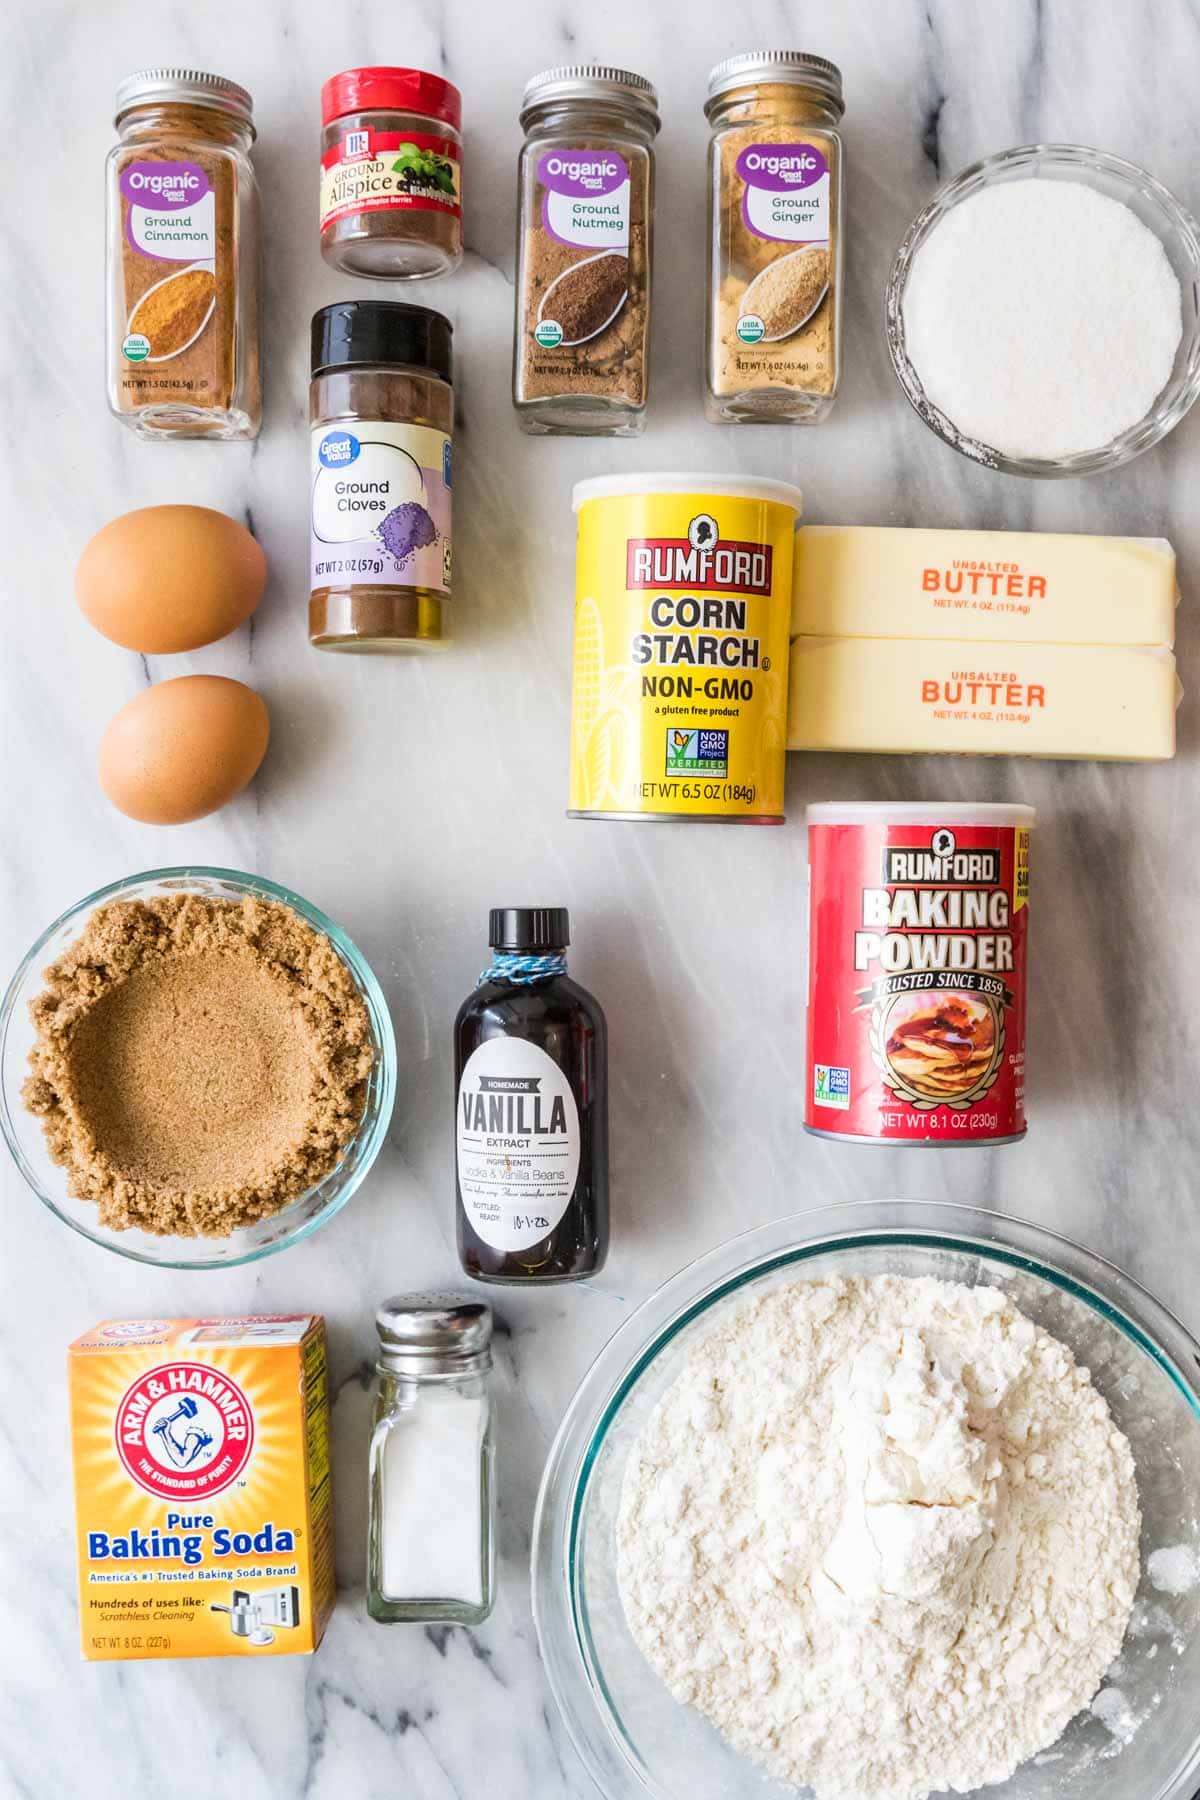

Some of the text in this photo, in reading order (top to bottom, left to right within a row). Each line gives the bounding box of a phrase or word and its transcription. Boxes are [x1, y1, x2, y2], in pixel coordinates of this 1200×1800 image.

[547, 157, 618, 180] Organic
[746, 152, 817, 175] Organic
[334, 161, 385, 184] GROUND
[129, 170, 200, 194] Organic
[329, 175, 393, 206] Allspice
[572, 203, 620, 215] Ground
[772, 197, 820, 208] Ground
[144, 216, 192, 227] Ground
[772, 211, 815, 224] Ginger
[572, 218, 625, 231] Nutmeg
[144, 230, 209, 241] Cinnamon
[742, 321, 759, 329] USDA
[751, 361, 761, 370] WT
[775, 362, 783, 370] OZ
[321, 440, 352, 453] Great
[335, 480, 390, 494] Ground
[337, 498, 387, 511] Cloves
[315, 559, 384, 575] NET WT 2 OZ (57g)
[633, 546, 768, 588] RUMFORD
[952, 560, 1019, 573] UNSALTED
[922, 569, 1047, 598] BUTTER
[651, 597, 747, 630] CORN
[933, 600, 951, 608] NET
[972, 601, 977, 609] 4
[996, 602, 1031, 615] (113.4g)
[631, 634, 760, 669] STARCH
[951, 671, 1017, 682] UNSALTED
[641, 675, 753, 701] NON-GMO
[921, 680, 1045, 708] BUTTER
[662, 705, 689, 715] gluten
[691, 706, 708, 715] free
[709, 707, 740, 717] product
[933, 710, 951, 719] NET
[700, 732, 726, 741] NON
[700, 741, 726, 750] GMO
[700, 749, 725, 758] Project
[669, 759, 725, 769] VERIFIED
[659, 783, 679, 798] WT
[682, 784, 701, 799] 6.5
[703, 784, 720, 799] OZ
[723, 784, 756, 804] (184g)
[891, 853, 994, 882] RUMFORD
[863, 889, 1009, 928] BAKING
[854, 932, 1013, 971] POWDER
[878, 971, 1004, 996] TRUSTED SINCE 1859
[830, 1070, 848, 1078] NON
[488, 1082, 529, 1090] HOMEMADE
[830, 1078, 848, 1086] GMO
[462, 1091, 567, 1134] VANILLA
[881, 1112, 998, 1130] NET WT 8.1 OZ (230g)
[486, 1138, 531, 1148] EXTRACT
[486, 1158, 532, 1167] INGREDIENTS
[500, 1169, 530, 1180] Vanilla
[532, 1169, 565, 1181] Beans
[124, 1370, 246, 1447] ARM & HAMMER
[139, 1455, 233, 1488] THE STANDARD OF PURITY
[167, 1514, 214, 1529] Pure
[88, 1524, 293, 1564] Baking Soda
[90, 1565, 296, 1582] America's #1 Trusted Baking Soda Brand
[89, 1597, 205, 1609] Hundreds of uses like:
[99, 1610, 195, 1622] Scratchless Cleaning
[92, 1637, 109, 1649] NET
[124, 1638, 130, 1648] 8
[146, 1637, 171, 1649] (227g)
